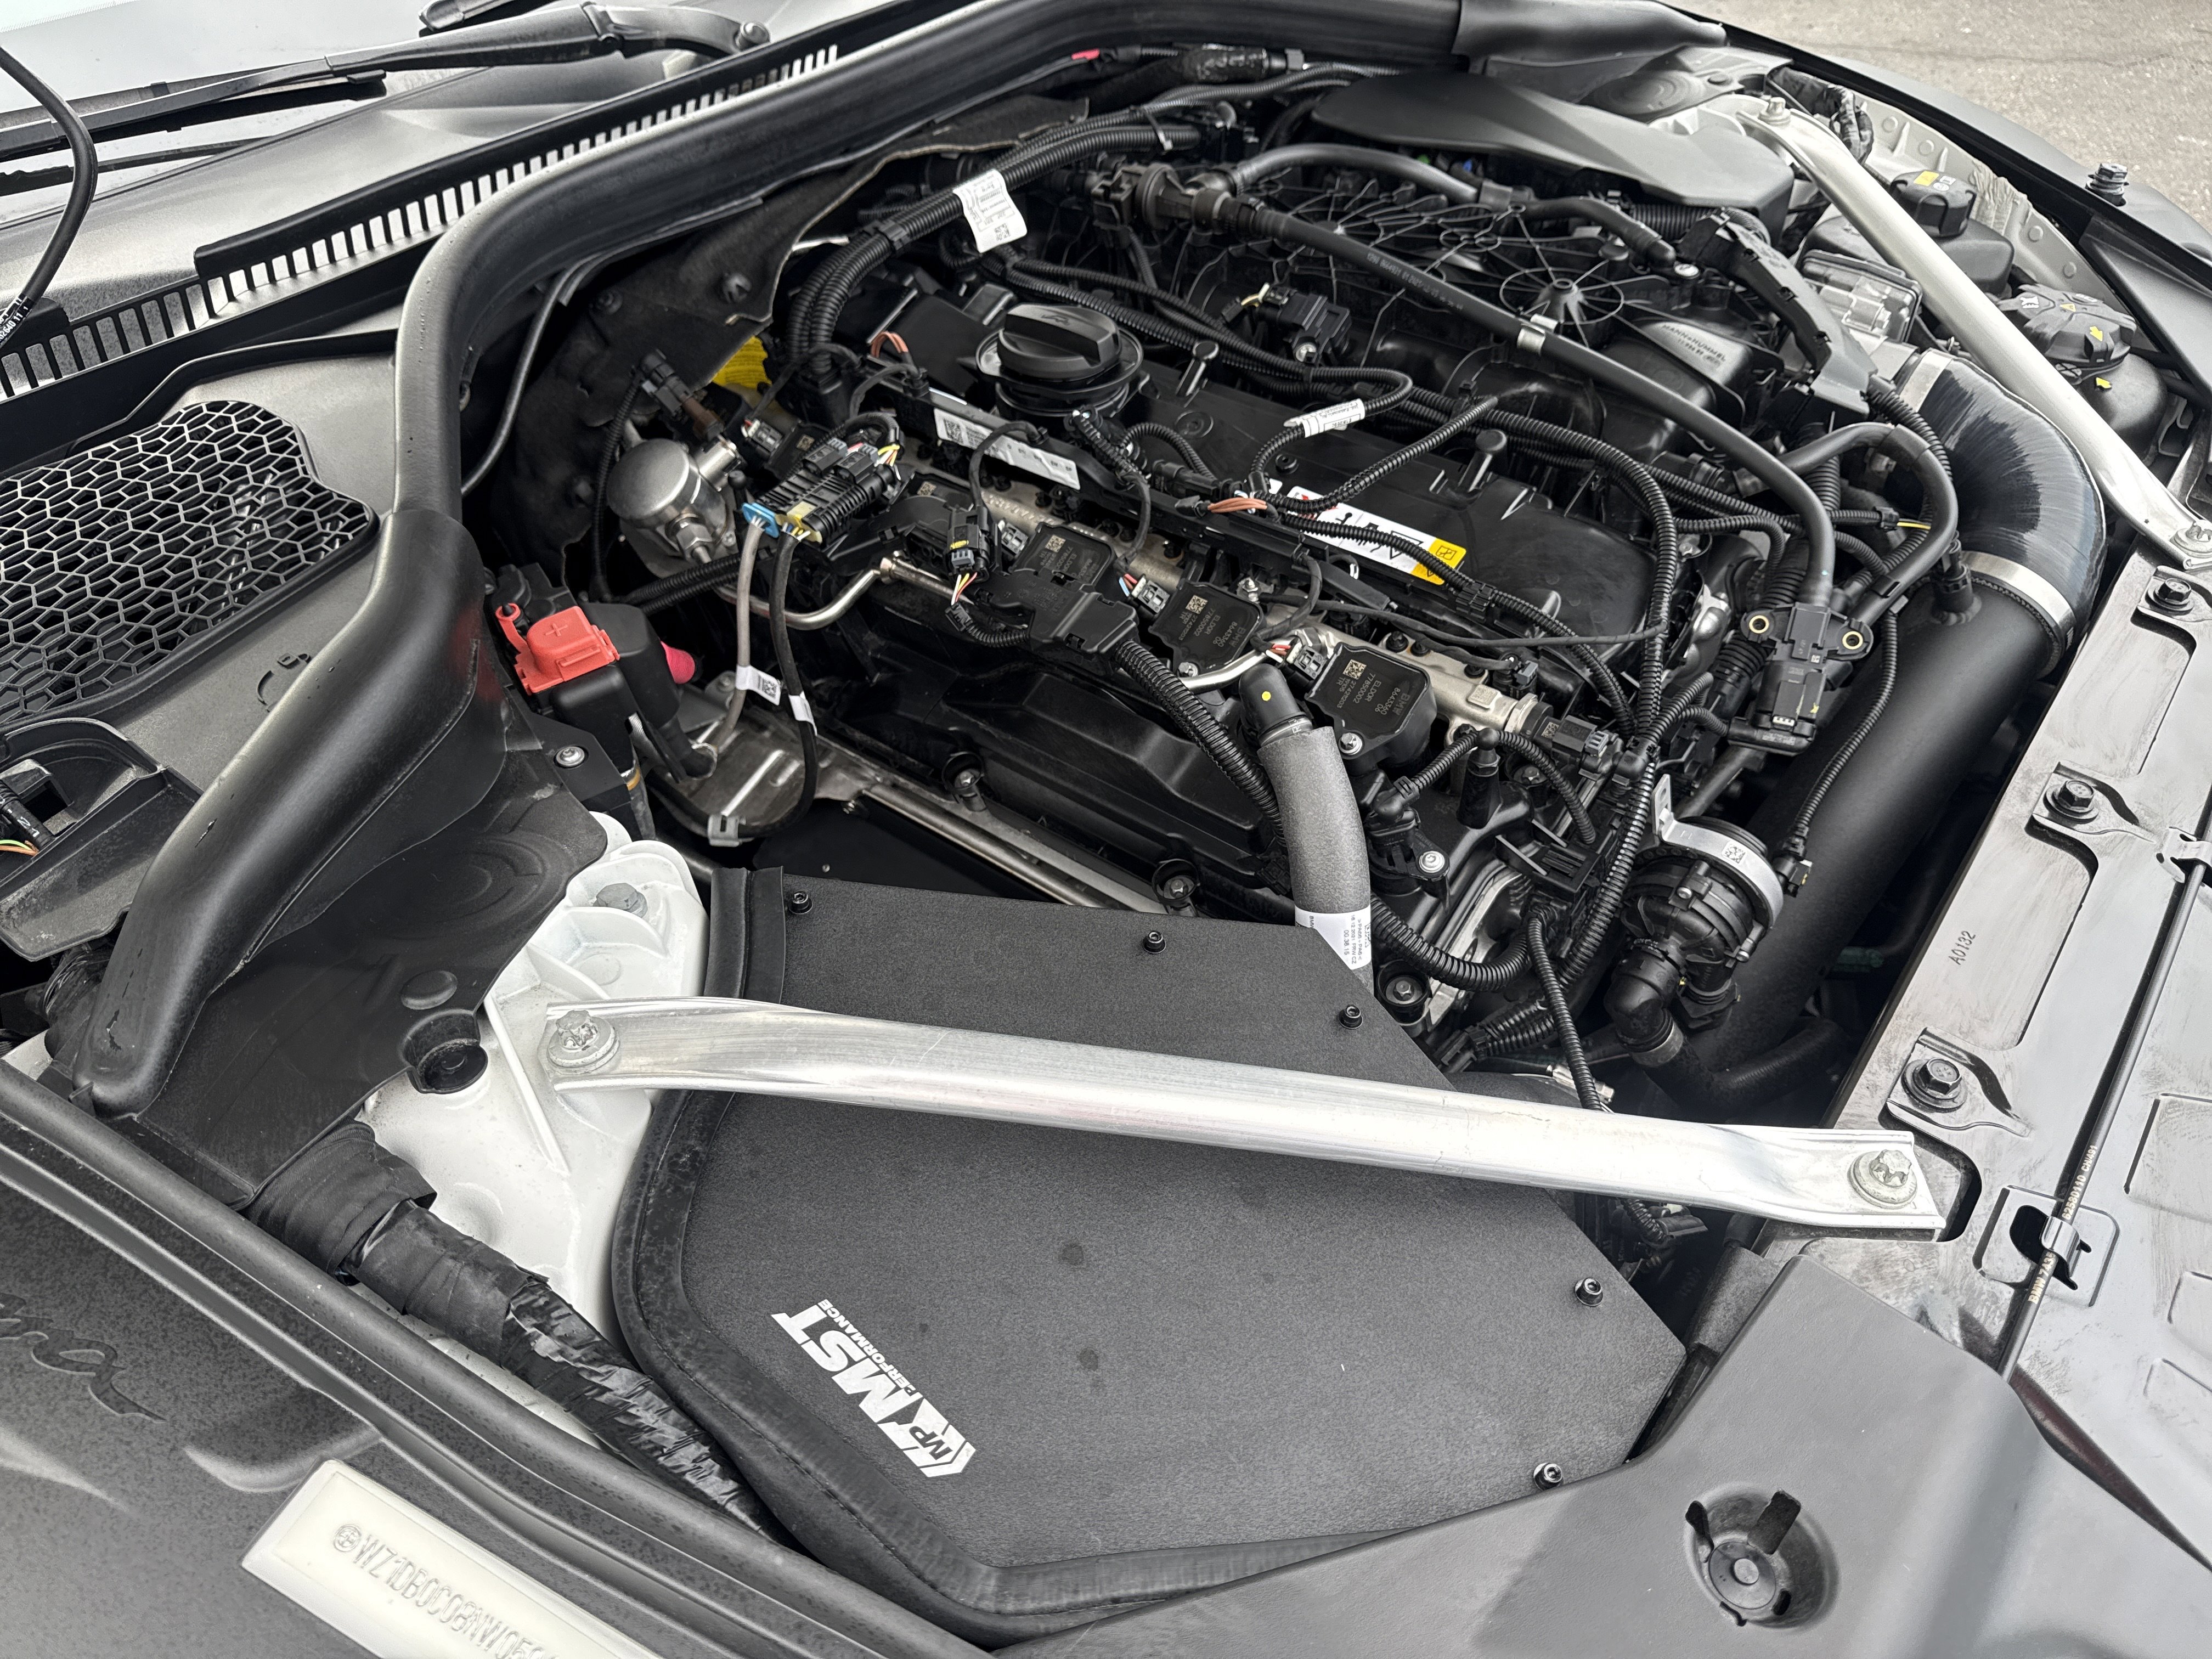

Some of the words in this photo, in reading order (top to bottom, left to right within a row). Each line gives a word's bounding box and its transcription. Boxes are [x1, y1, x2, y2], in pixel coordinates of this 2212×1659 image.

[1194, 607, 1216, 637] 77850002
[1204, 614, 1221, 635] ELDOR
[1218, 621, 1238, 648] 8643360
[1212, 636, 1221, 645] 06
[1231, 627, 1246, 648] BMW
[1335, 676, 1346, 685] TR
[1352, 673, 1376, 704] 77850002
[1366, 680, 1382, 702] ELDOR
[1374, 703, 1384, 713] 06
[1380, 687, 1401, 716] 8643360
[1392, 693, 1411, 716] BMW
[1948, 930, 1976, 966] A0132
[2027, 1277, 2046, 1304] BMW
[817, 1299, 919, 1396] PERFORMANCE
[771, 1304, 923, 1423] MST
[909, 1425, 953, 1460] MP
